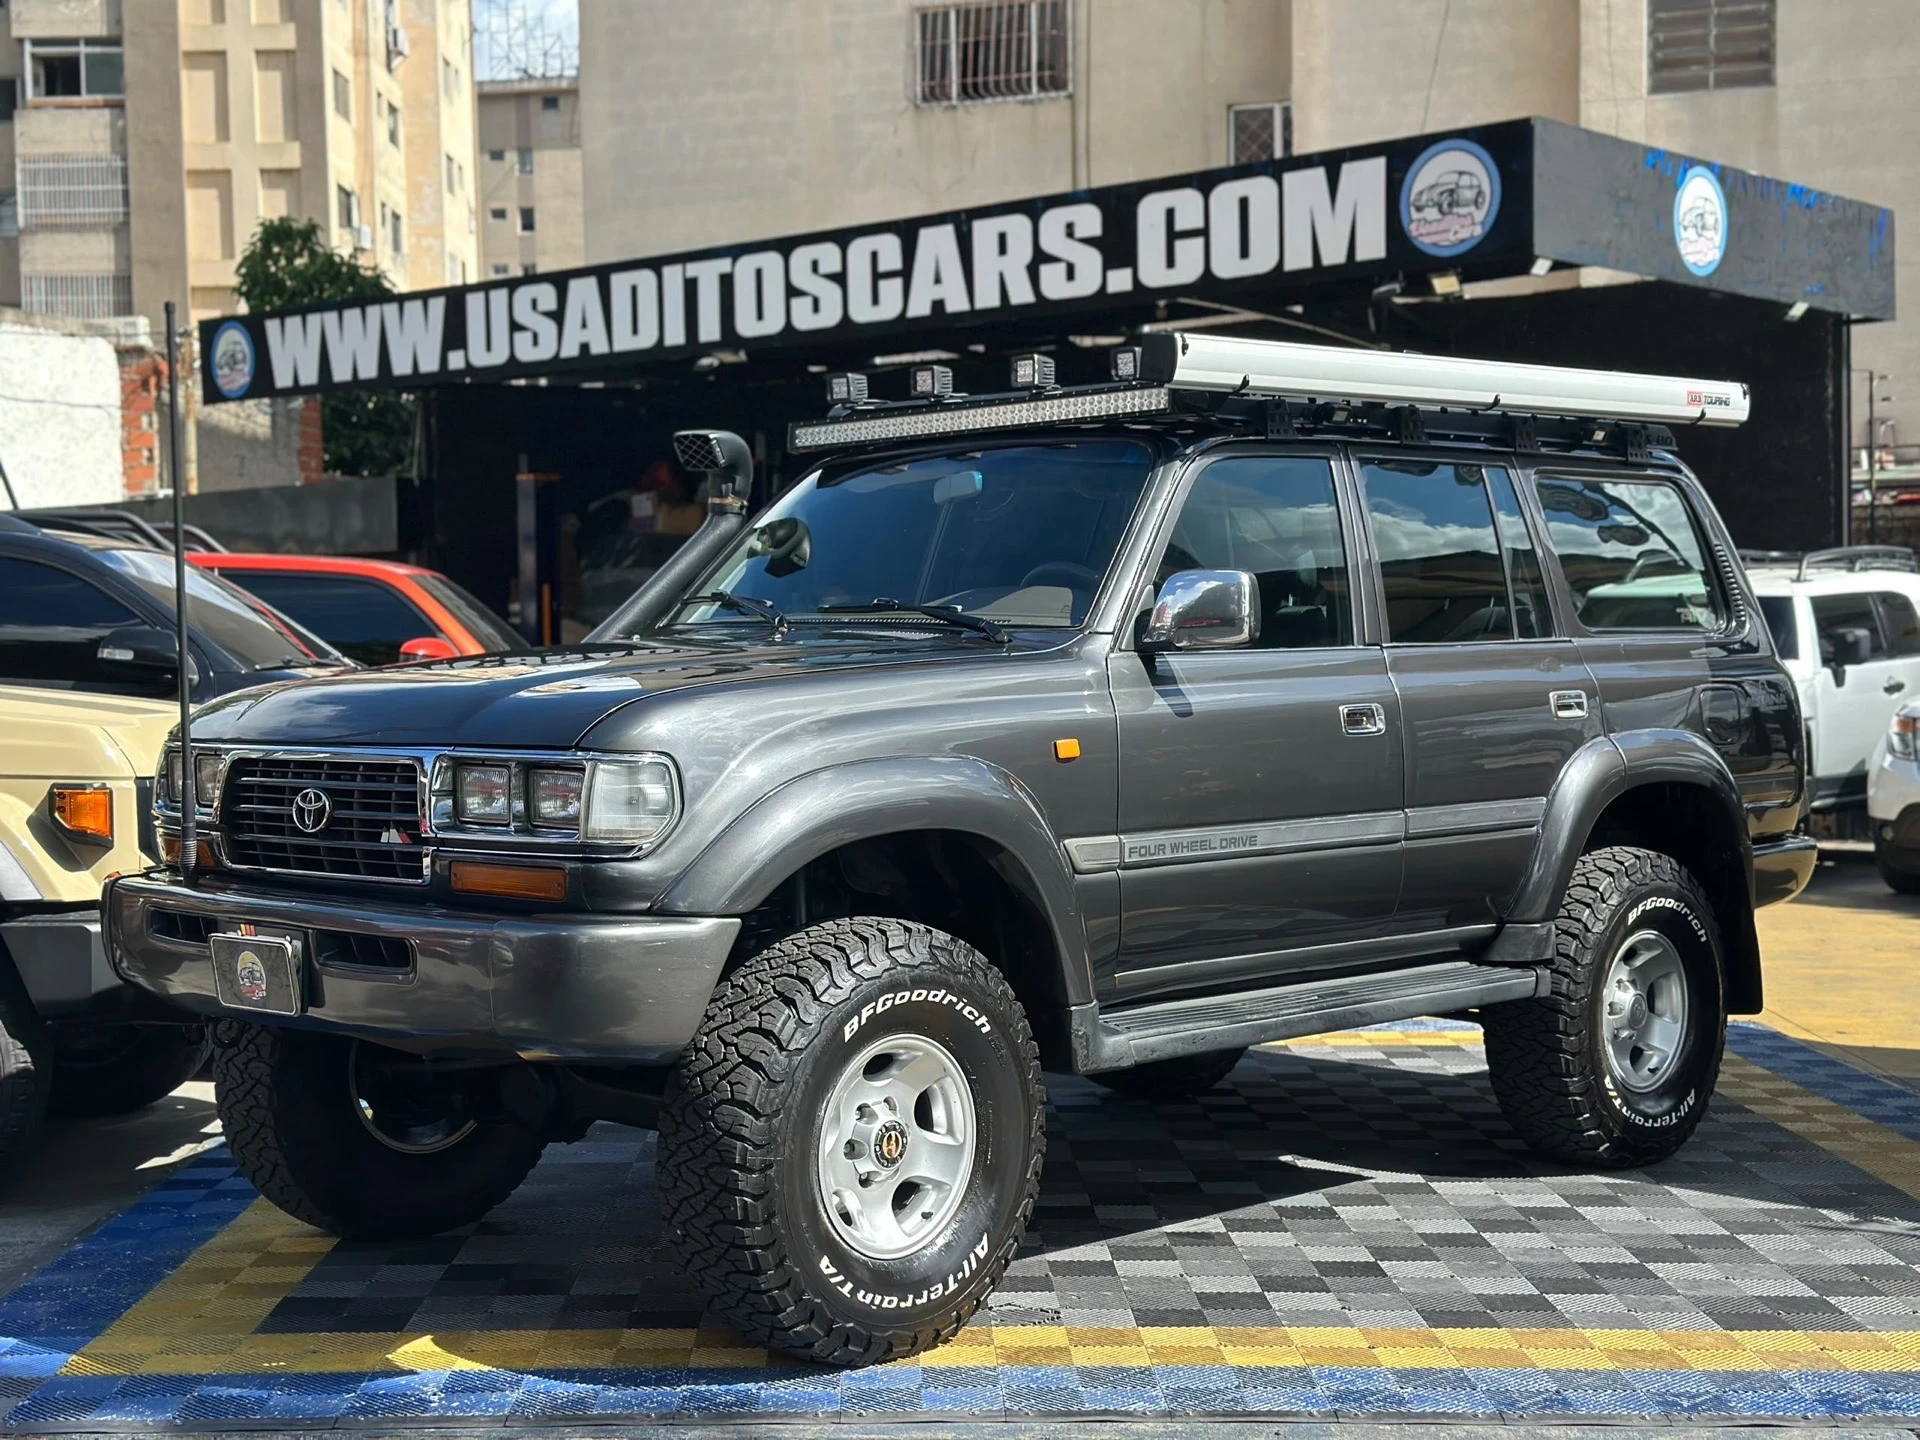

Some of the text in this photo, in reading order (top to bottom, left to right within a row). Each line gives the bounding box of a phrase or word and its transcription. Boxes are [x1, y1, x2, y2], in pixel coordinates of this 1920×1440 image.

[264, 155, 1387, 390] WWW.USADITOSCARS.COM
[1704, 395, 1730, 406] TOURING
[1128, 835, 1258, 859] FOUR WHEEL DRIVE
[1627, 896, 1707, 943] BFGoodrich
[844, 988, 992, 1043] BFGoodrich
[818, 1232, 990, 1310] All-Terrain T/A
